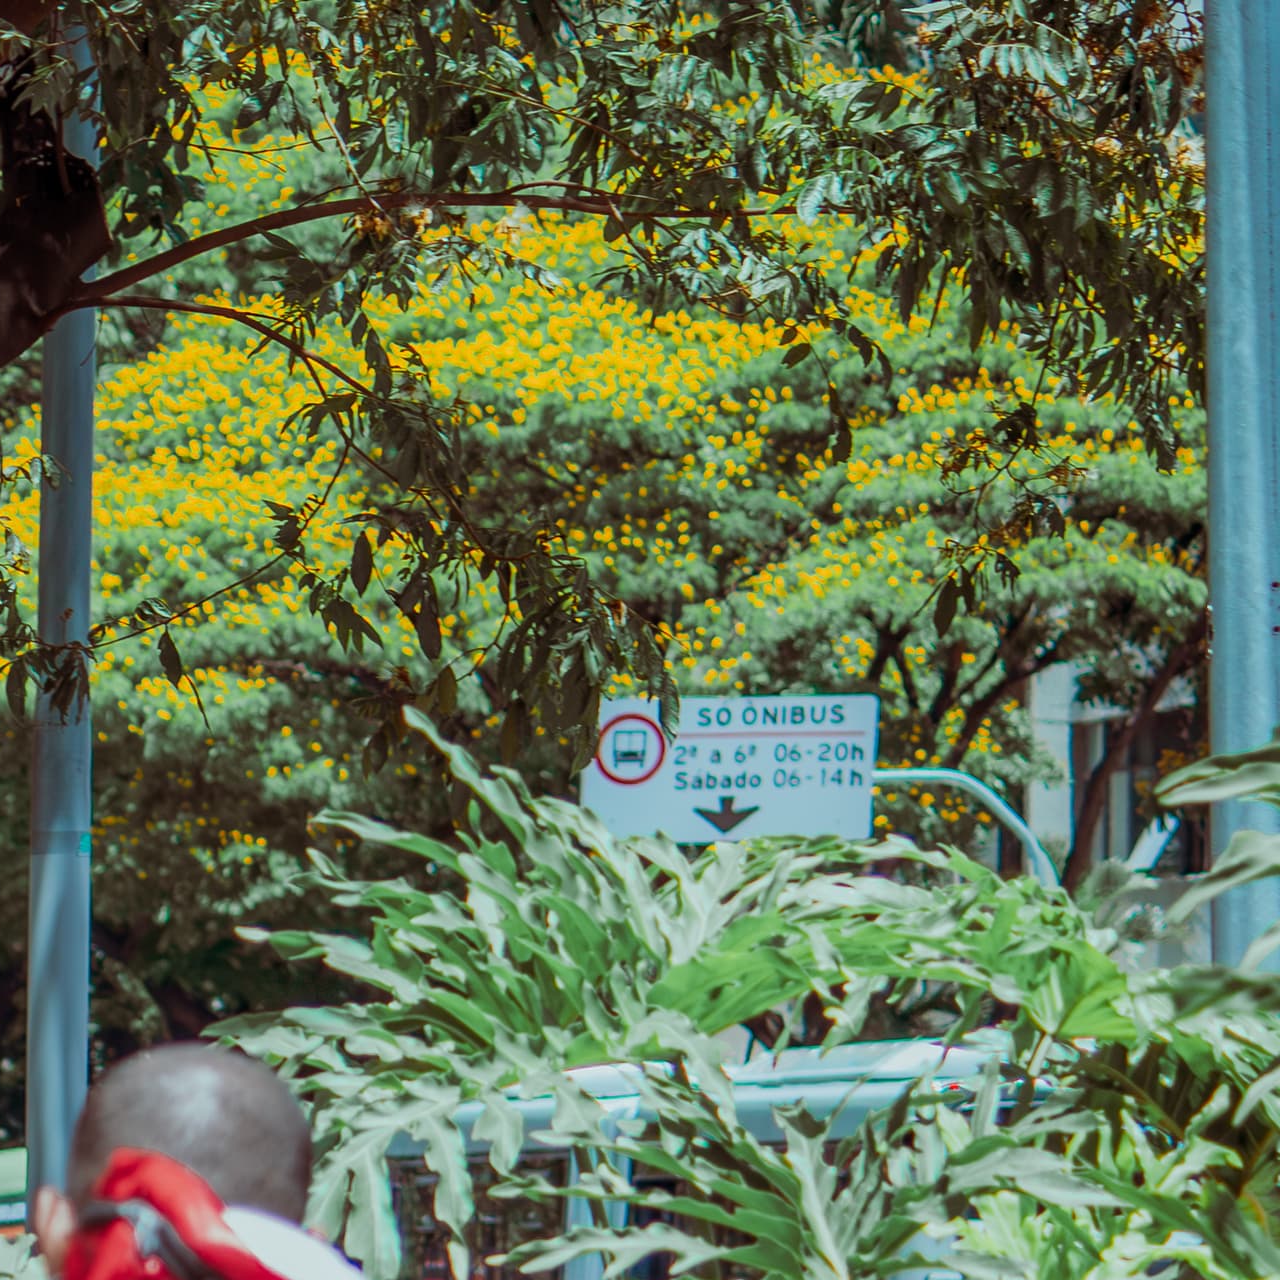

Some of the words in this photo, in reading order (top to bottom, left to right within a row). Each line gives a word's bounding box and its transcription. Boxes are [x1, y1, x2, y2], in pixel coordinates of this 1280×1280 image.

[709, 748, 722, 765] a
[774, 742, 865, 763] 06-20h
[772, 768, 863, 788] 06-14h
